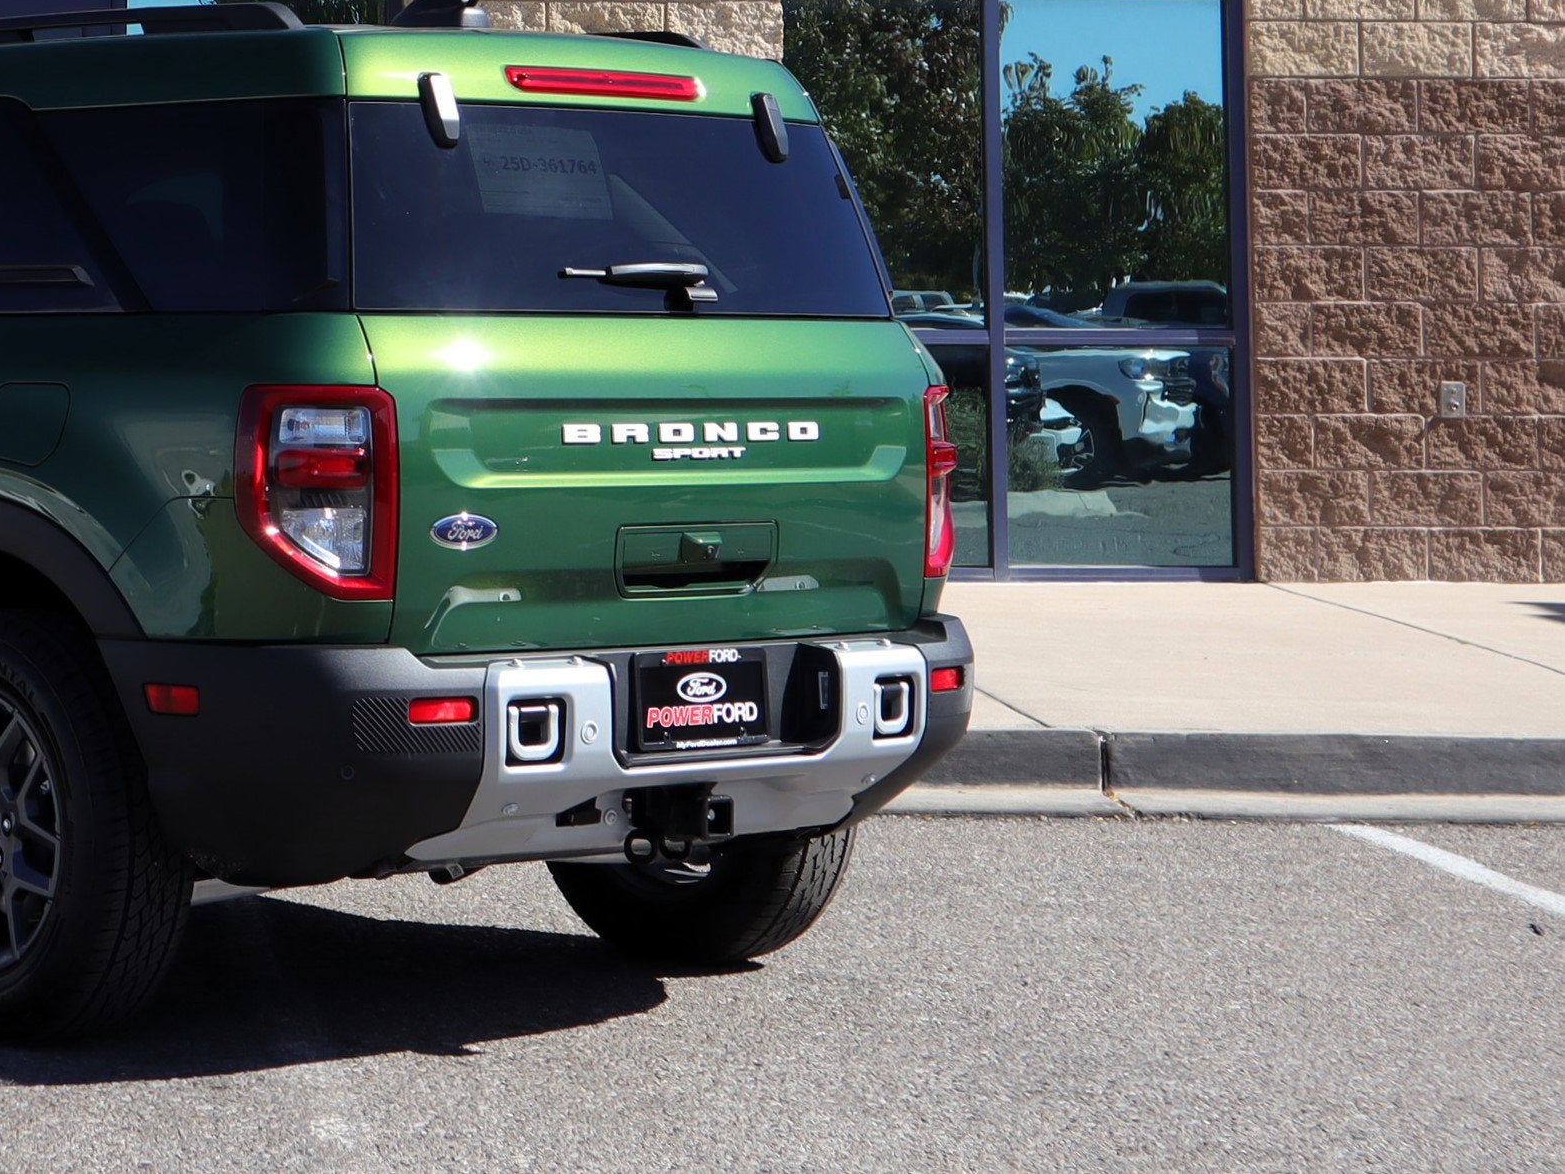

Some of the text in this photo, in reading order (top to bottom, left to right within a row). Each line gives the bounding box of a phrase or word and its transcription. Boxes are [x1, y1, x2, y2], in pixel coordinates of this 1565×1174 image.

[562, 421, 820, 445] BRONCO
[652, 446, 747, 461] SPORT
[447, 520, 484, 540] Ford
[665, 649, 739, 665] POWERFORD
[686, 677, 717, 696] Ford
[647, 701, 759, 728] POWERFORD
